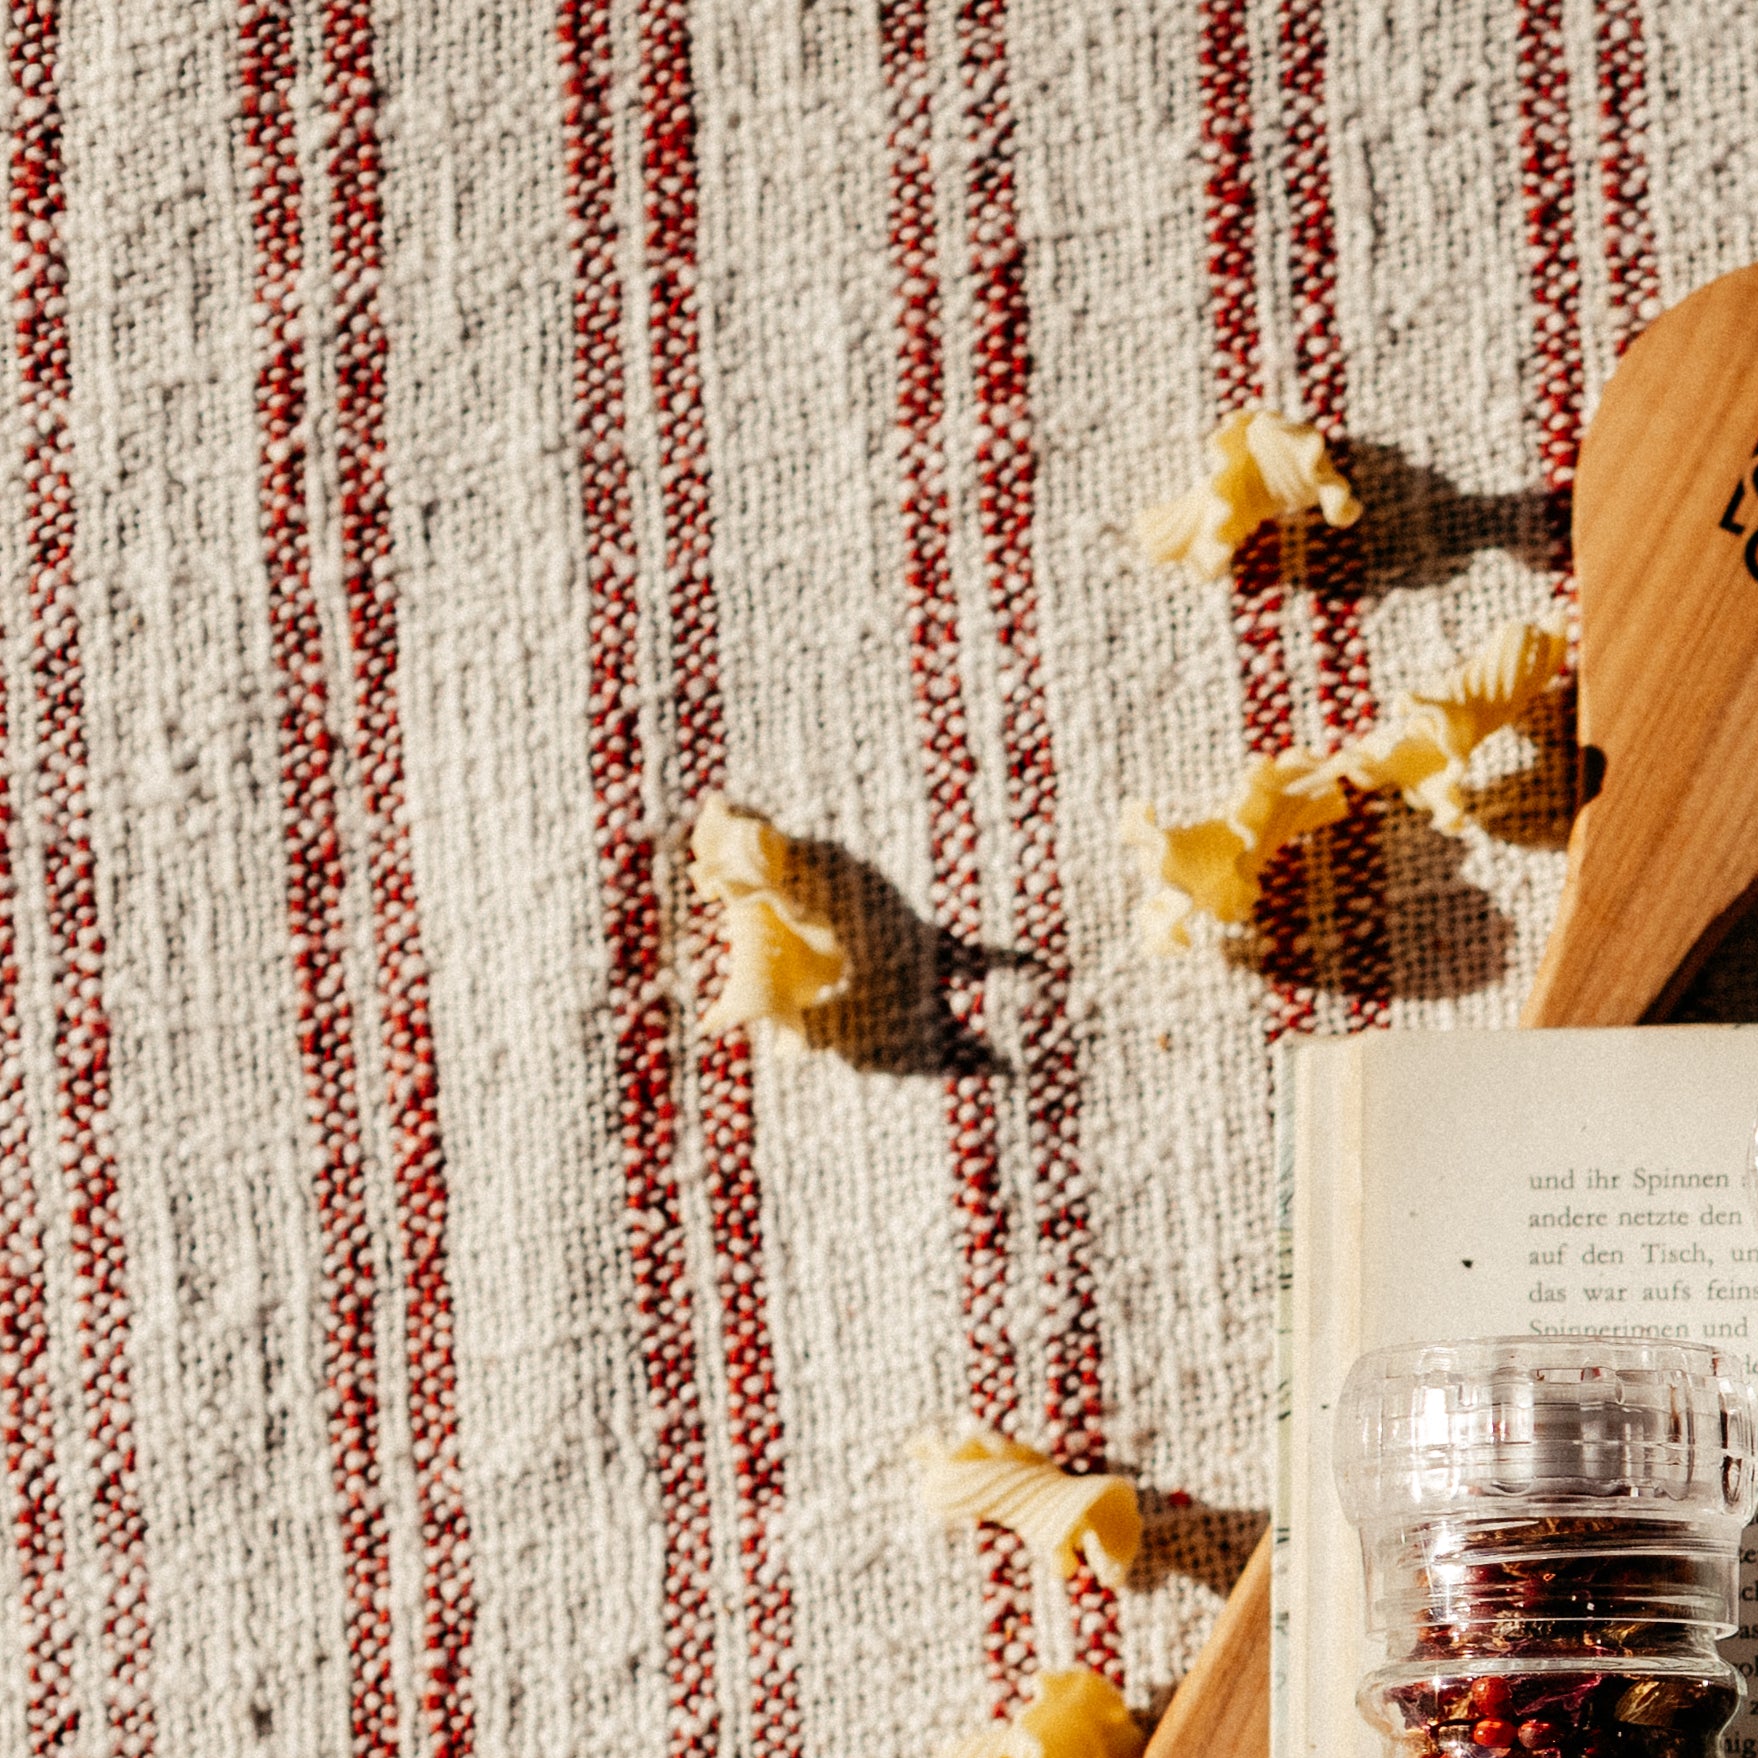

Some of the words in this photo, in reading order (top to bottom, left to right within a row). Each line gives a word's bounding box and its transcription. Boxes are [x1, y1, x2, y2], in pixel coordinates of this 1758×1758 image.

[1529, 1168, 1574, 1190] und
[1588, 1168, 1620, 1190] ihr
[1633, 1167, 1729, 1196] Spinnen
[1529, 1204, 1607, 1226] andere
[1619, 1207, 1688, 1226] netzte
[1700, 1203, 1742, 1225] den
[1529, 1243, 1568, 1265] auf
[1581, 1242, 1623, 1264] den
[1529, 1280, 1566, 1302] das
[1583, 1286, 1627, 1301] war
[1642, 1279, 1691, 1301] aufs
[1703, 1315, 1748, 1337] und
